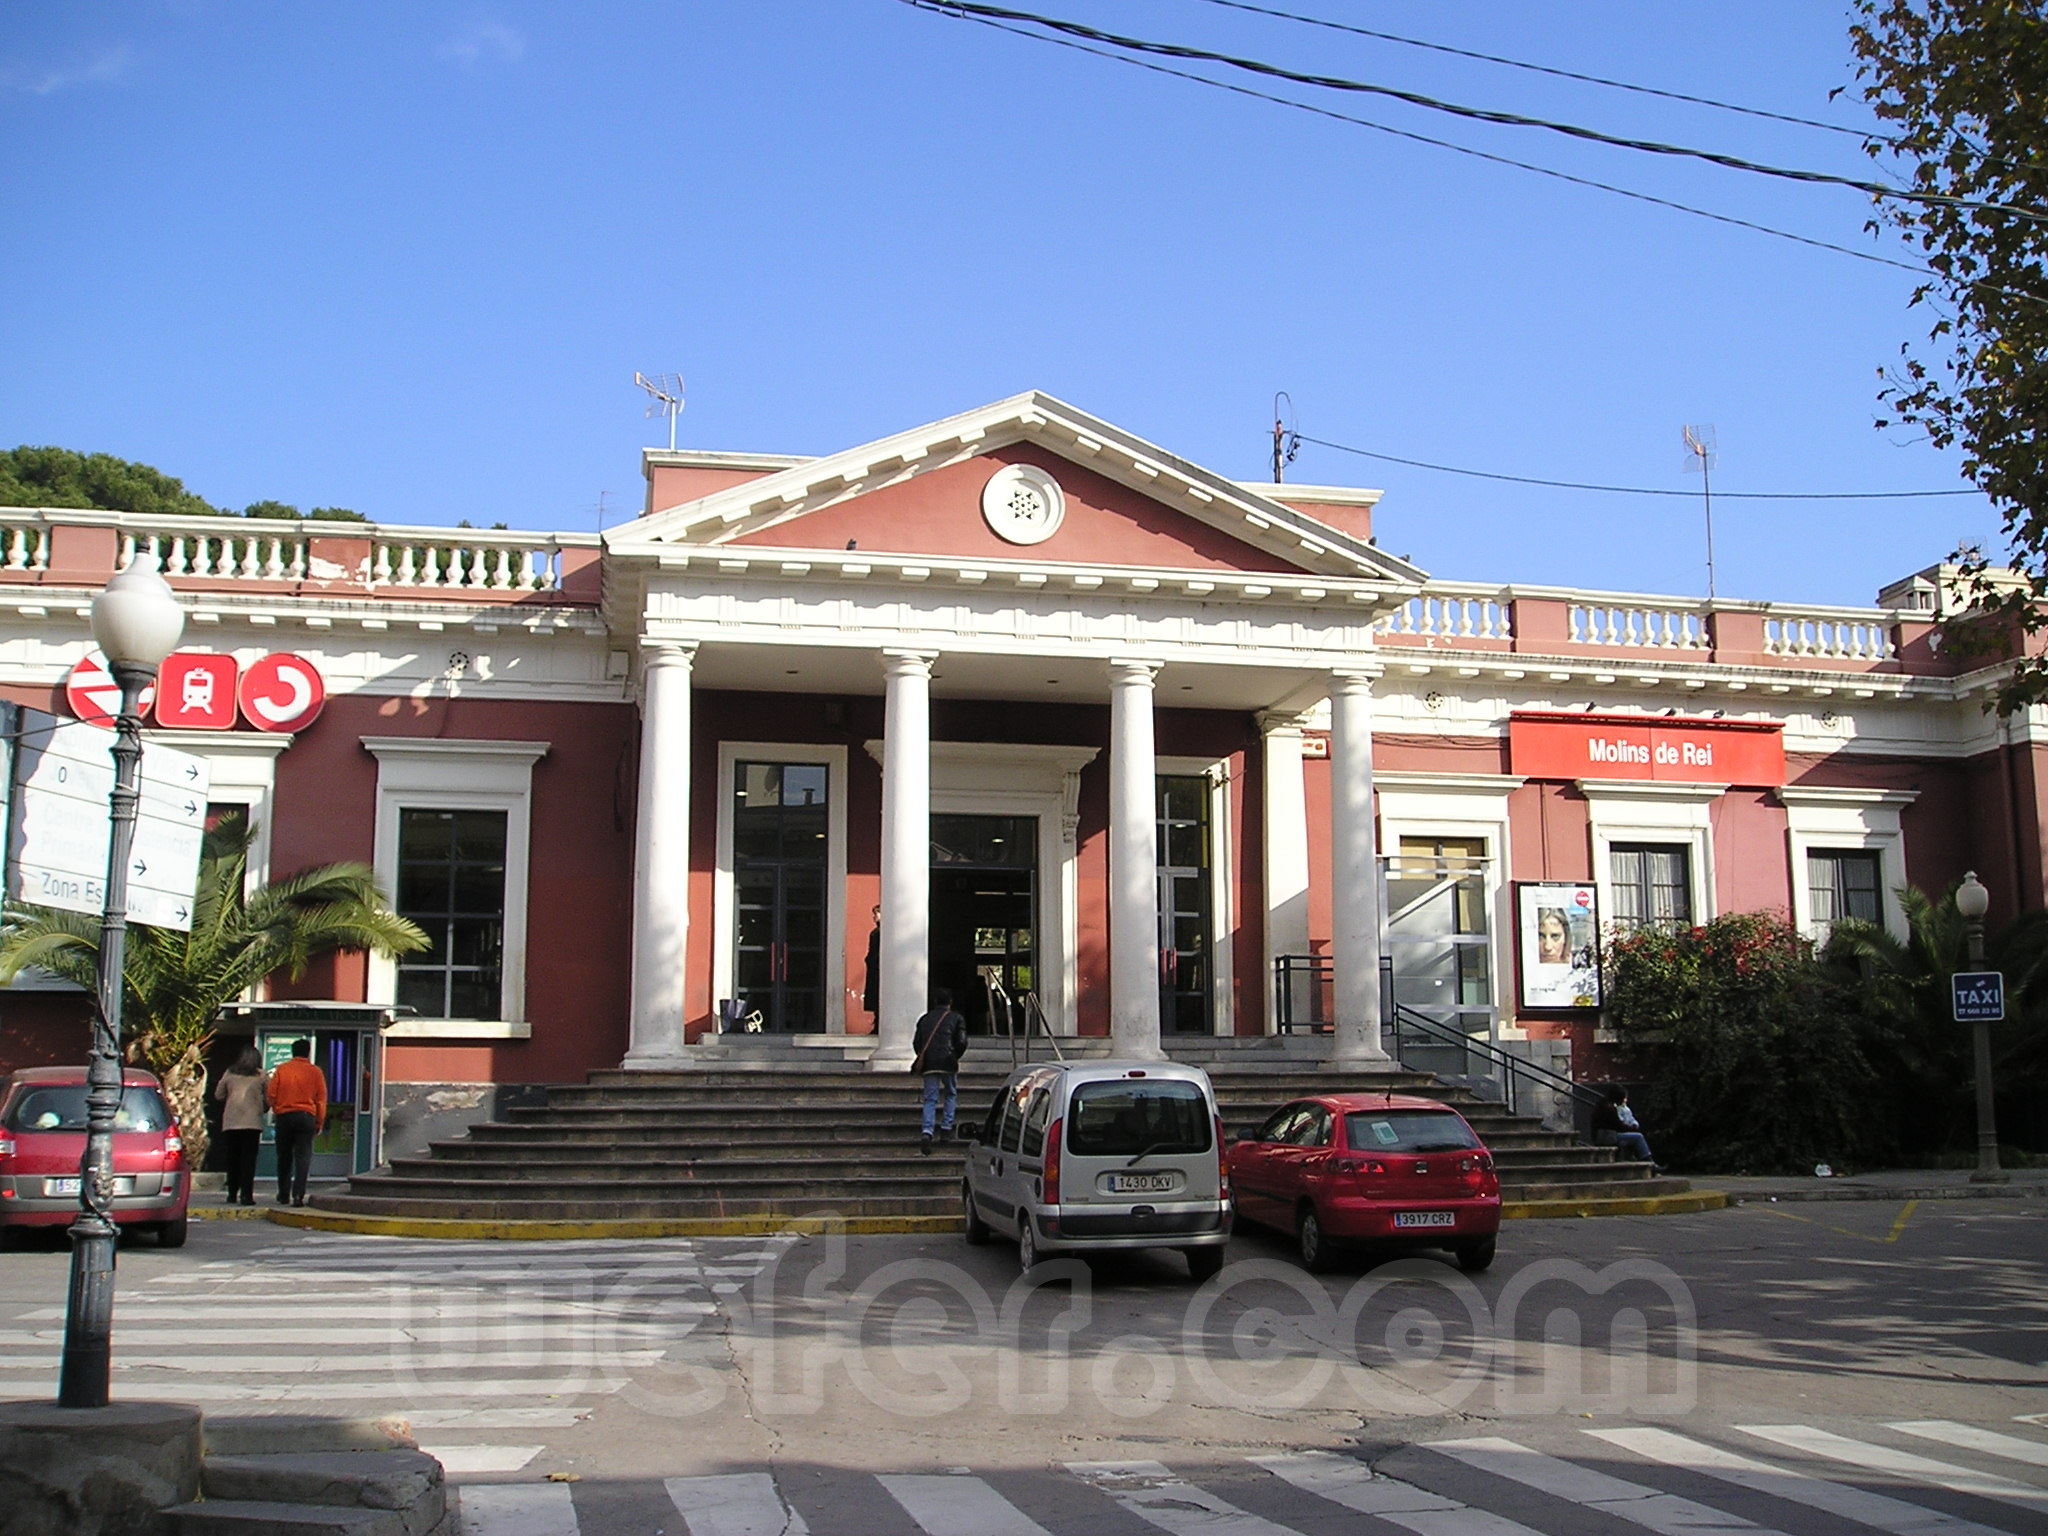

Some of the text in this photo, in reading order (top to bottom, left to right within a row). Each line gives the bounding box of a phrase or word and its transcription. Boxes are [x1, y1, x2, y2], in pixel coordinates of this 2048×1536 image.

[1589, 738, 1712, 766] Molins de Rei
[41, 872, 79, 898] Zona
[1957, 989, 1999, 1004] TAXI
[1120, 1176, 1171, 1188] 1430 DKV
[1402, 1213, 1452, 1224] 3917 CRZ
